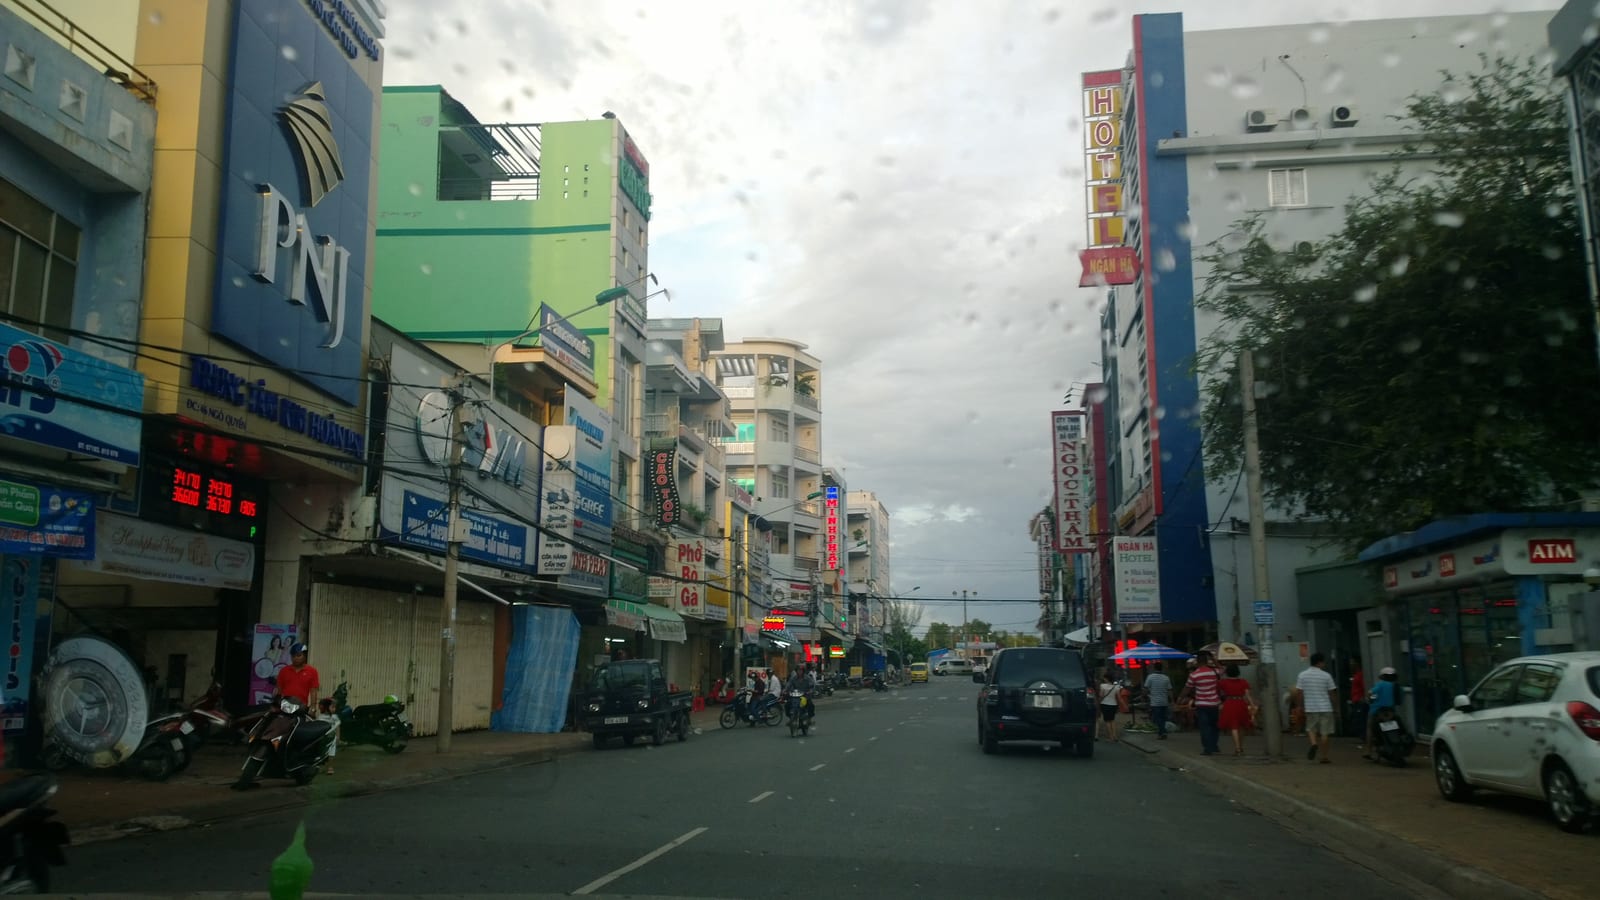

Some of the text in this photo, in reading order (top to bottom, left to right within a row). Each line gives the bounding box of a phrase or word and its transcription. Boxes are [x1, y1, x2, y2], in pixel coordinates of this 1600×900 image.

[1093, 88, 1121, 244] HOTEL
[253, 183, 351, 349] PNJ
[546, 312, 591, 360] Panasonic
[576, 415, 604, 443] DAIKIN
[581, 497, 606, 518] GREE
[678, 540, 703, 562] Phở
[1119, 553, 1155, 563] HOTEL
[1532, 543, 1574, 559] ATM
[682, 564, 698, 584] Bò
[681, 586, 699, 607] Gà
